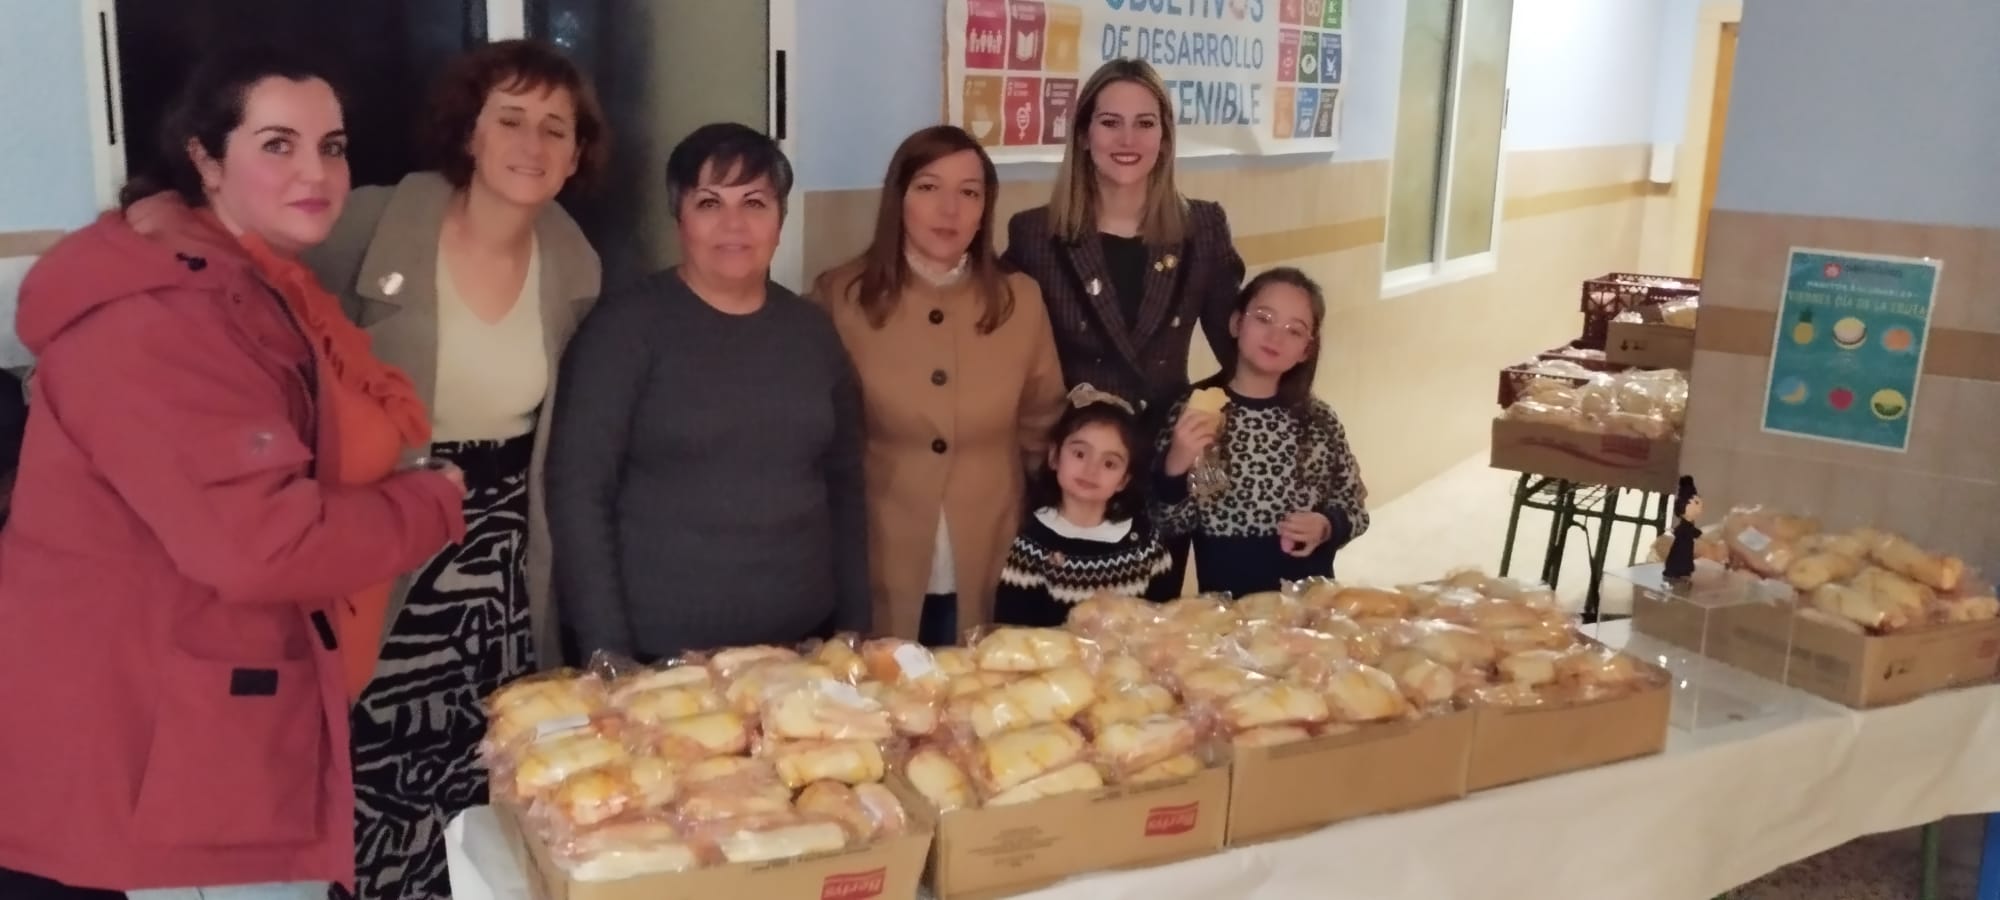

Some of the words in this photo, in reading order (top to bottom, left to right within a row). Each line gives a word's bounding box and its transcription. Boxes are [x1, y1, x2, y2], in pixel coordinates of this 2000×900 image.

[1102, 23, 1131, 61] DE
[1136, 26, 1264, 70] DESARROLLO
[1166, 80, 1261, 125] ENIBLE
